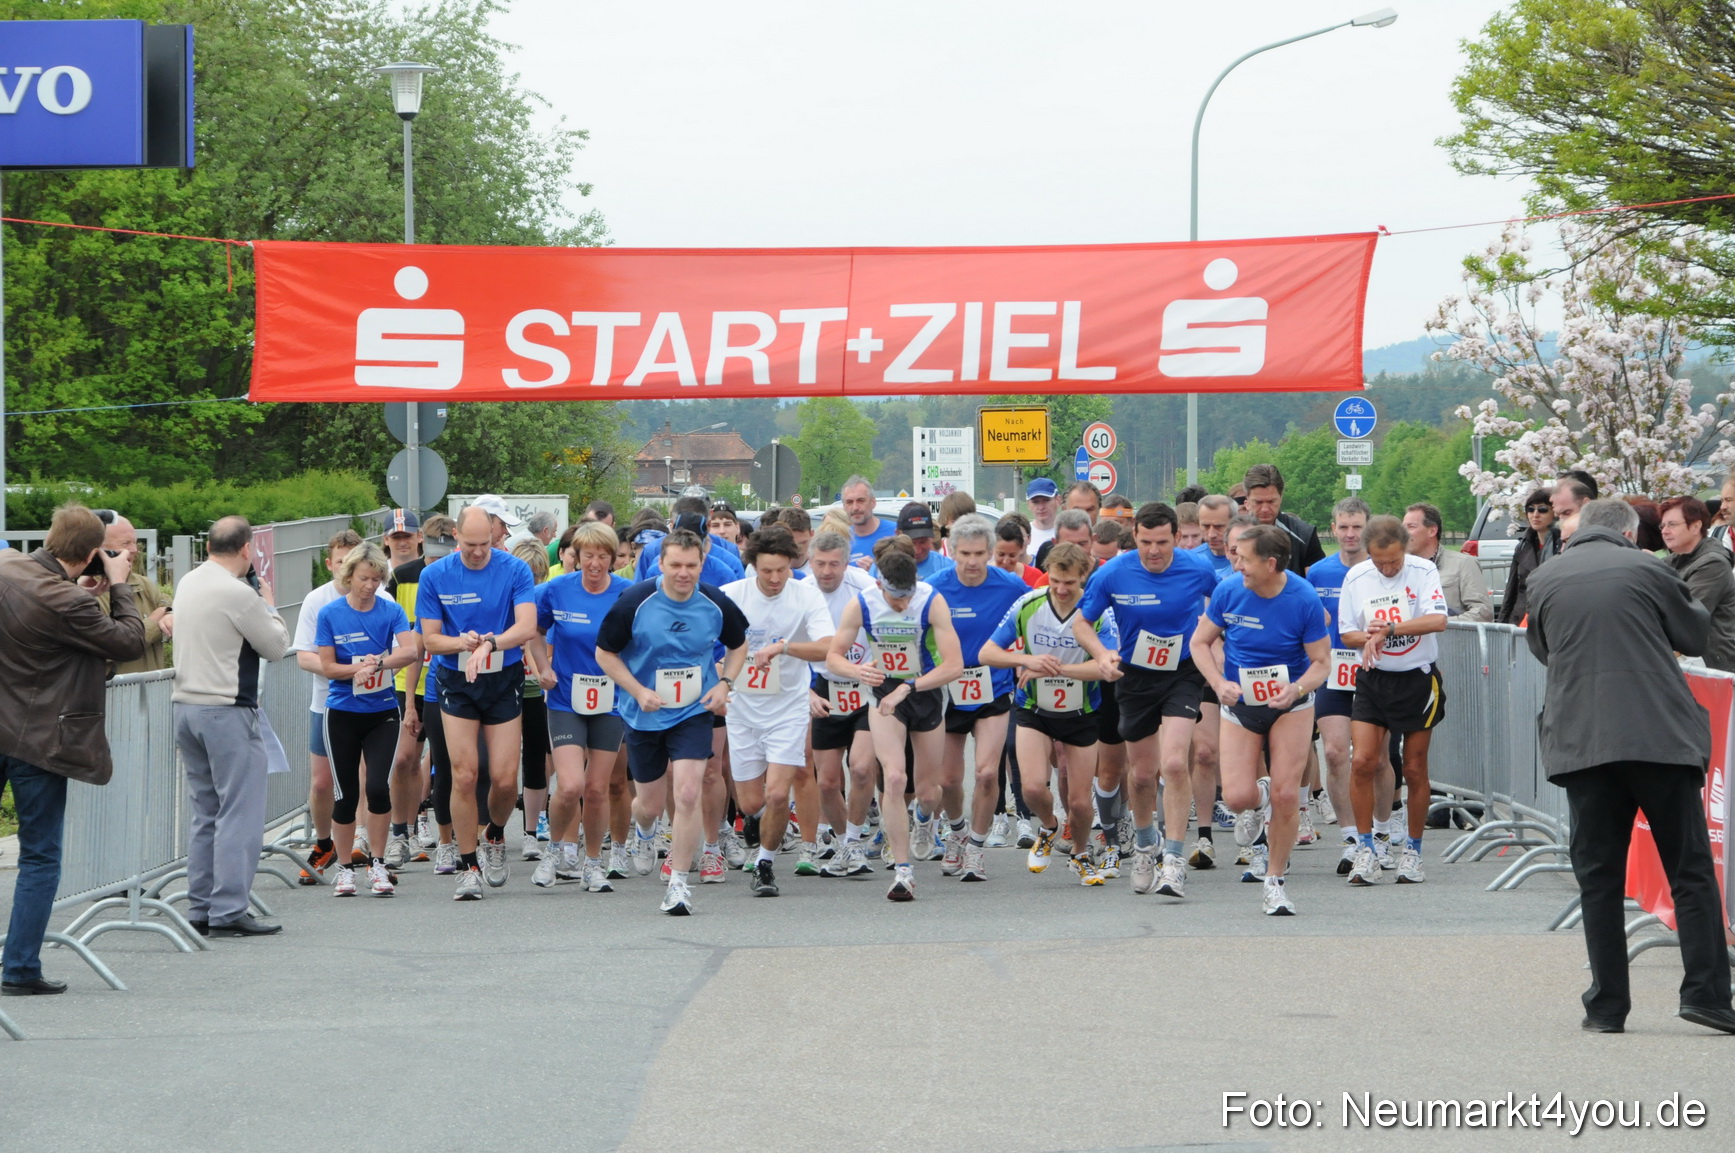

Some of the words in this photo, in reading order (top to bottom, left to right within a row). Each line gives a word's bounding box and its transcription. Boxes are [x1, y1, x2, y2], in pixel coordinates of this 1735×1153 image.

[987, 428, 1042, 442] Neumarkt
[1091, 433, 1109, 448] 60
[927, 465, 939, 479] SHB
[1370, 596, 1390, 604] MEYER
[1034, 633, 1080, 648] BOC
[1146, 635, 1168, 644] MEYER
[882, 652, 909, 671] 92
[1147, 646, 1170, 667] 16
[748, 666, 770, 689] 27
[586, 688, 598, 710] 9
[673, 680, 681, 703] 1
[958, 679, 982, 701] 73
[1053, 688, 1066, 709] 2
[1252, 680, 1281, 702] 66
[837, 690, 861, 712] 59
